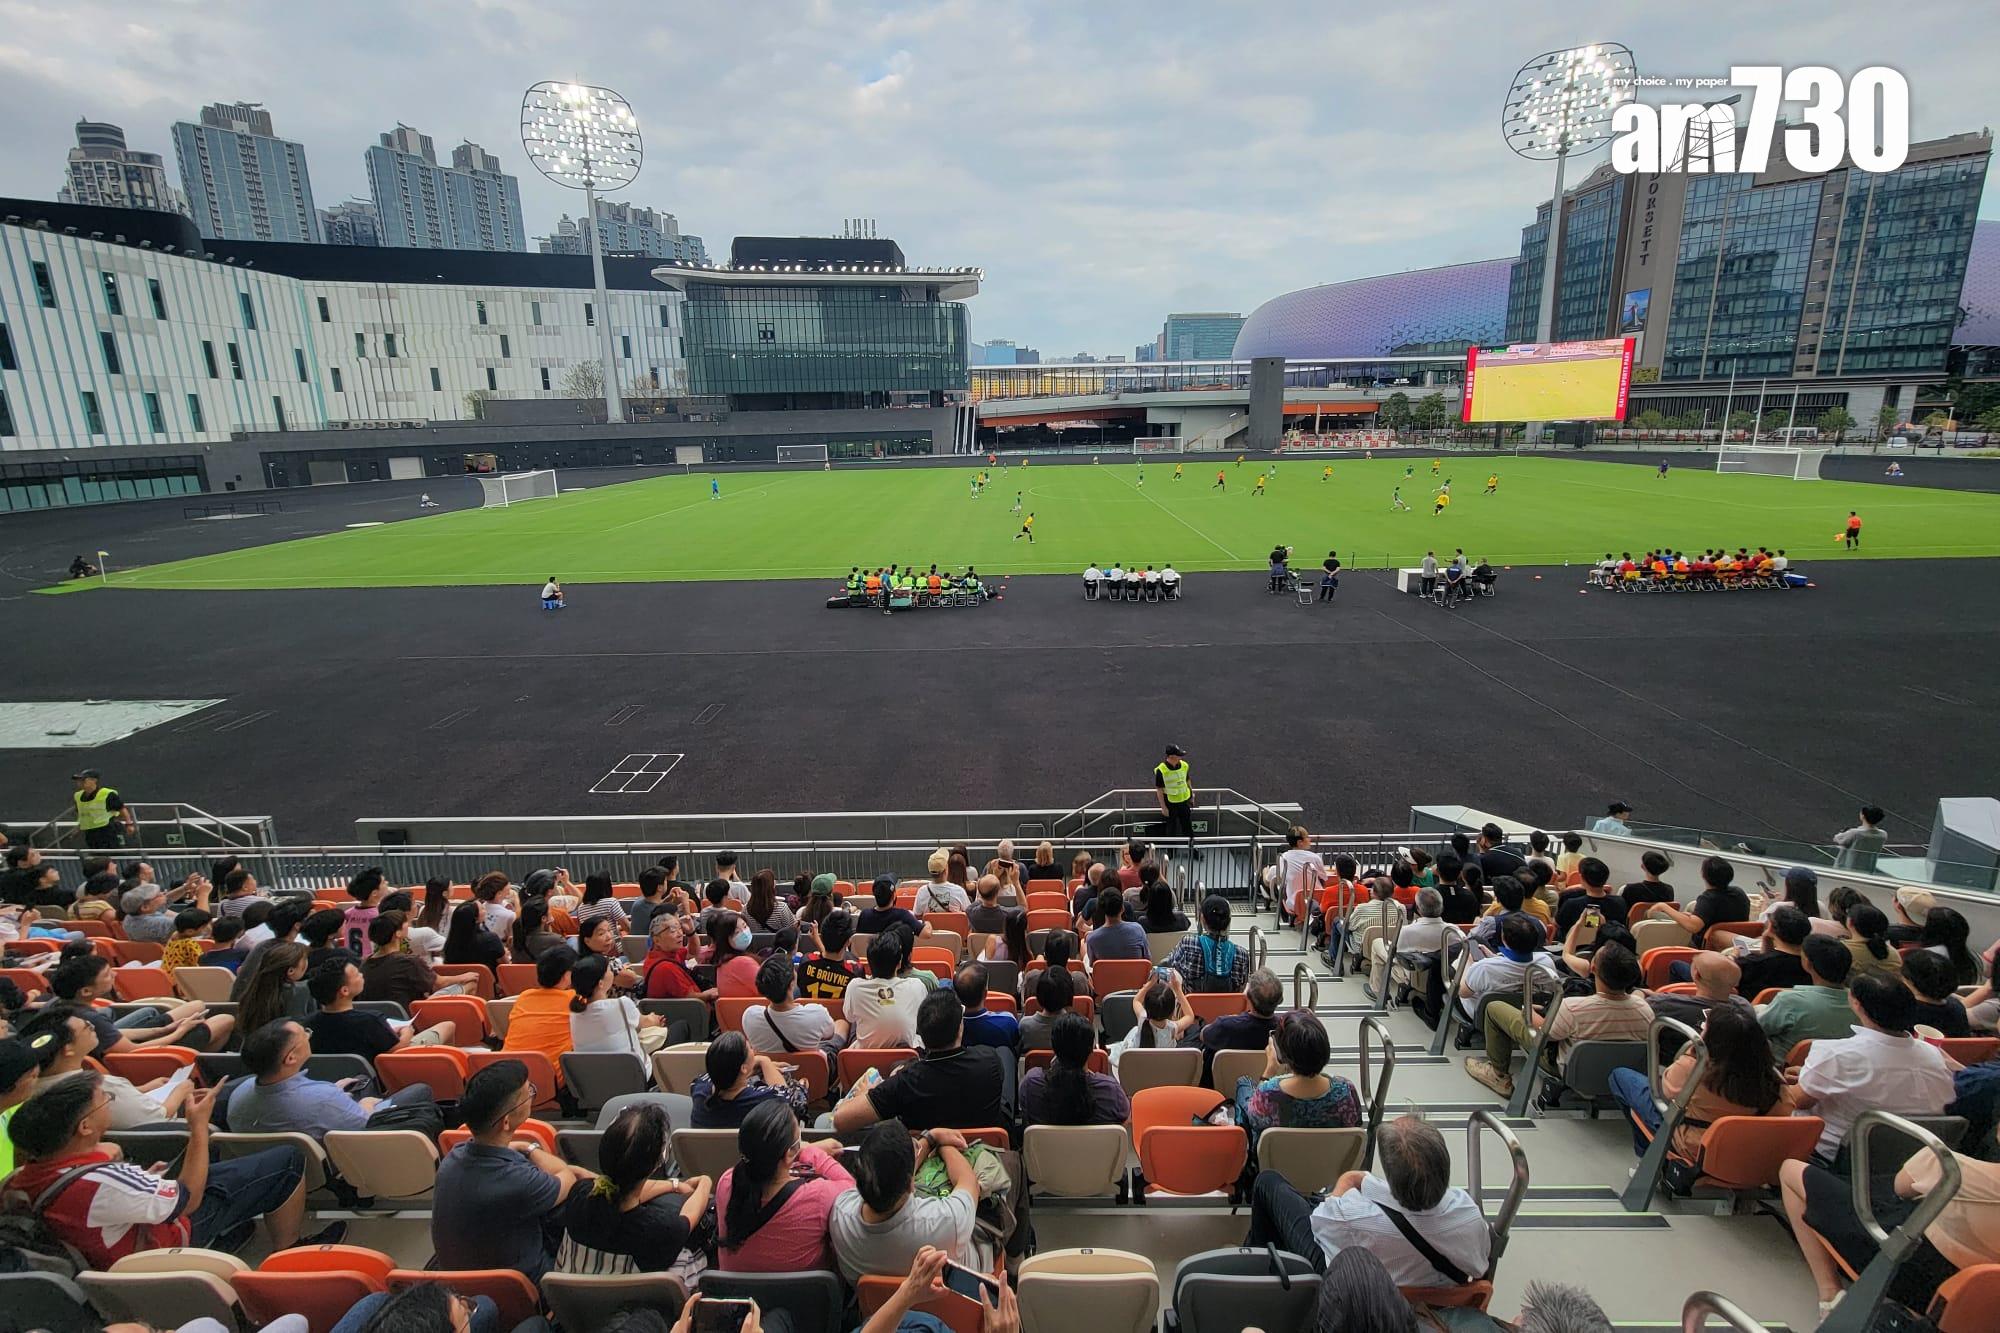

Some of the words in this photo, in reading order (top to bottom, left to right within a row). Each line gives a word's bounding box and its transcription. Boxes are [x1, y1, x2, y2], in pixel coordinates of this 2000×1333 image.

[806, 964, 816, 977] DE
[816, 968, 850, 986] BRUYNE
[806, 981, 844, 1000] 17
